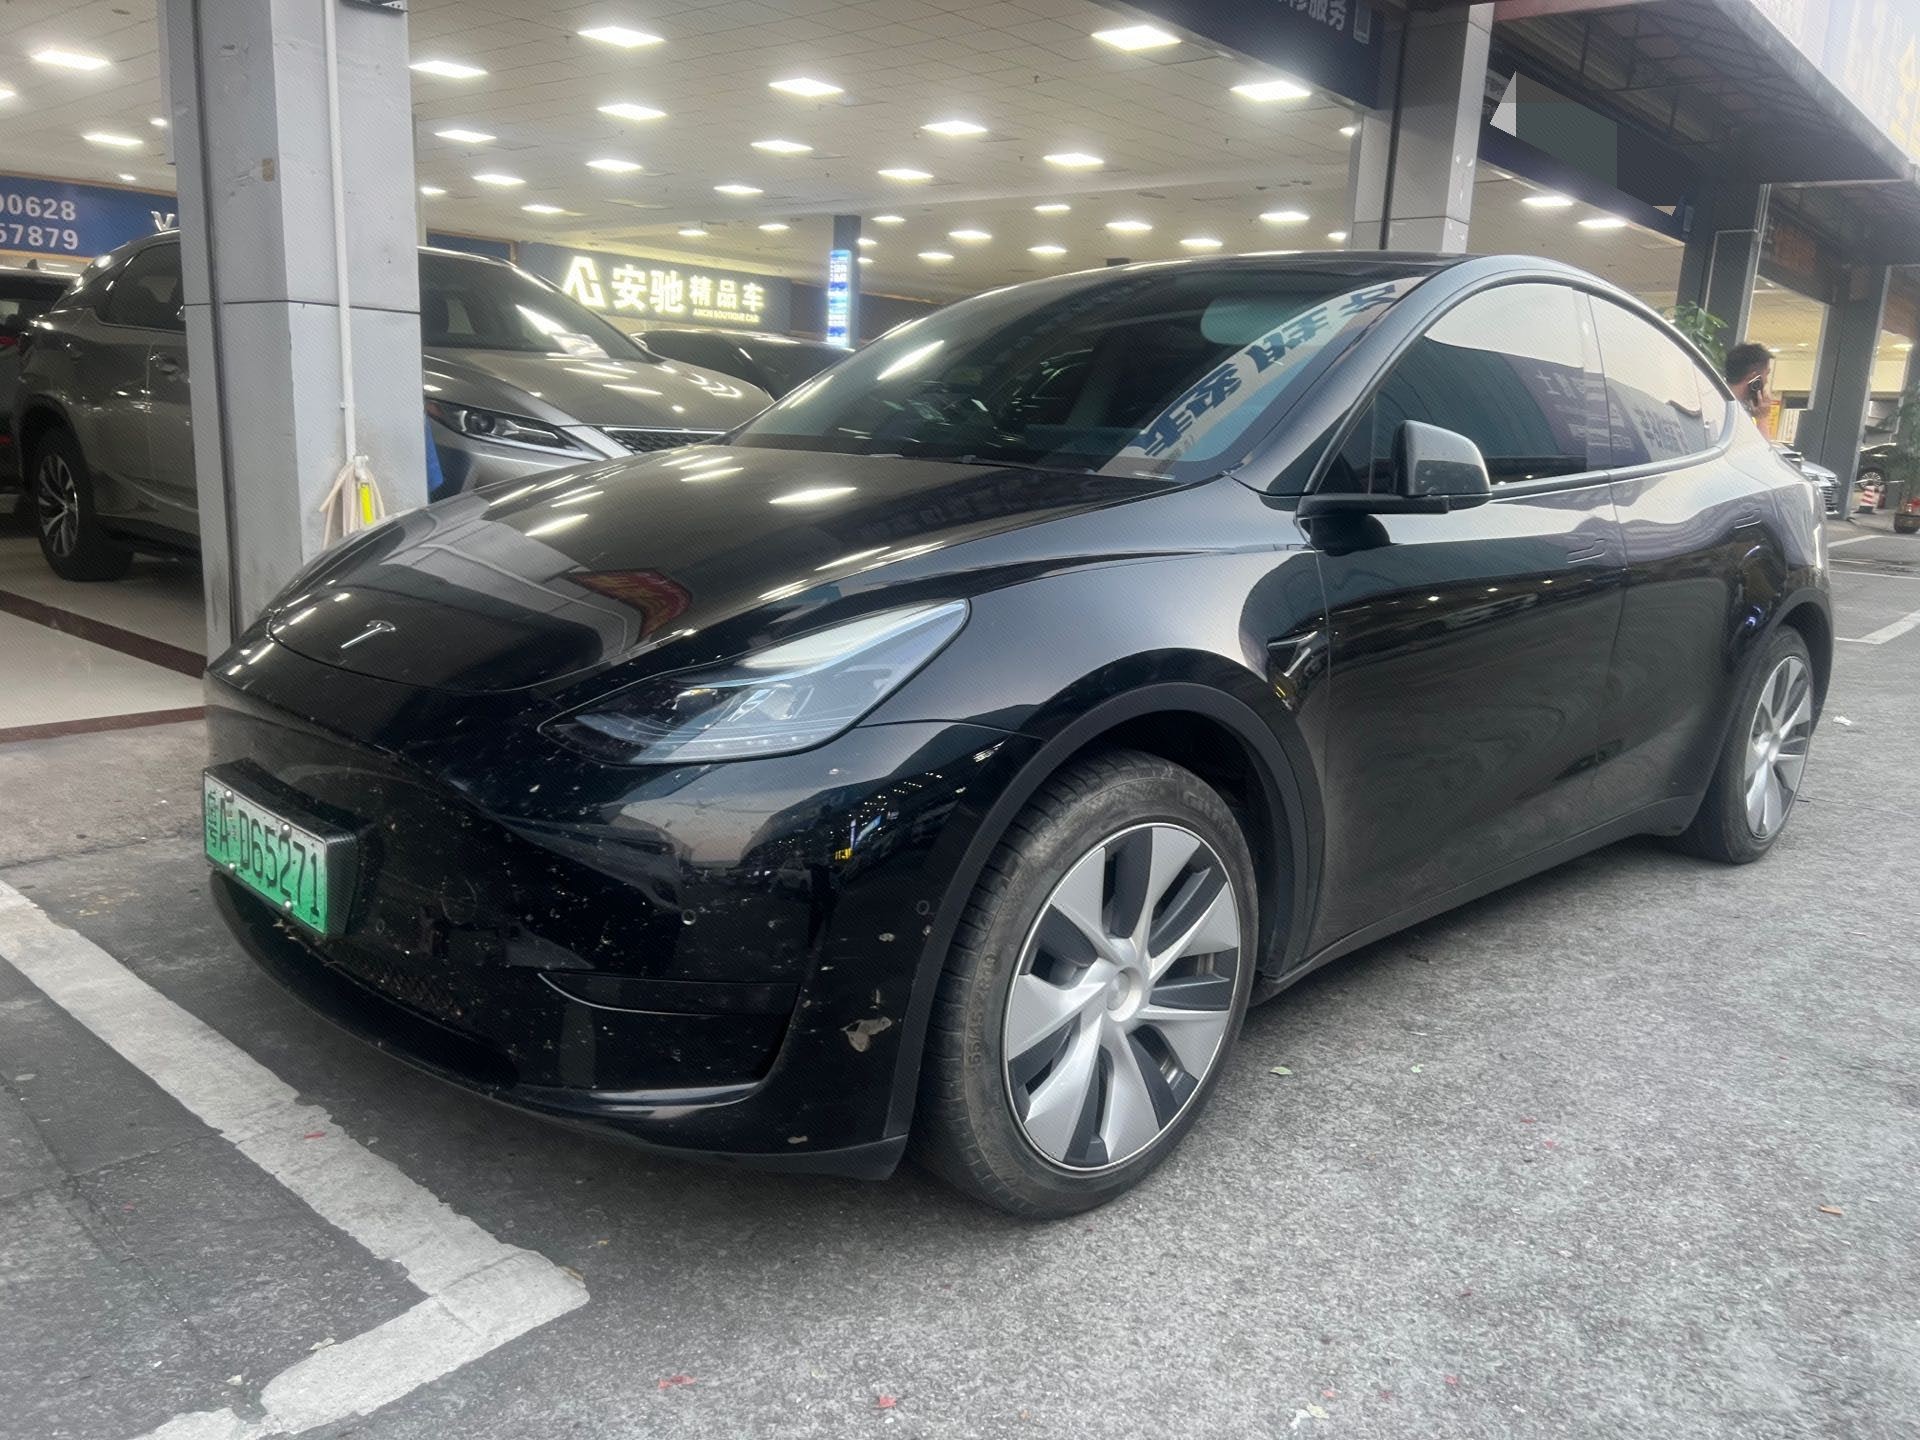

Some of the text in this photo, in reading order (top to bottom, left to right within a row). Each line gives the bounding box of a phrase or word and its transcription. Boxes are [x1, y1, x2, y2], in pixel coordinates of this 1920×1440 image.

[0, 193, 77, 221] 0628
[611, 264, 765, 313] 安驰精品车
